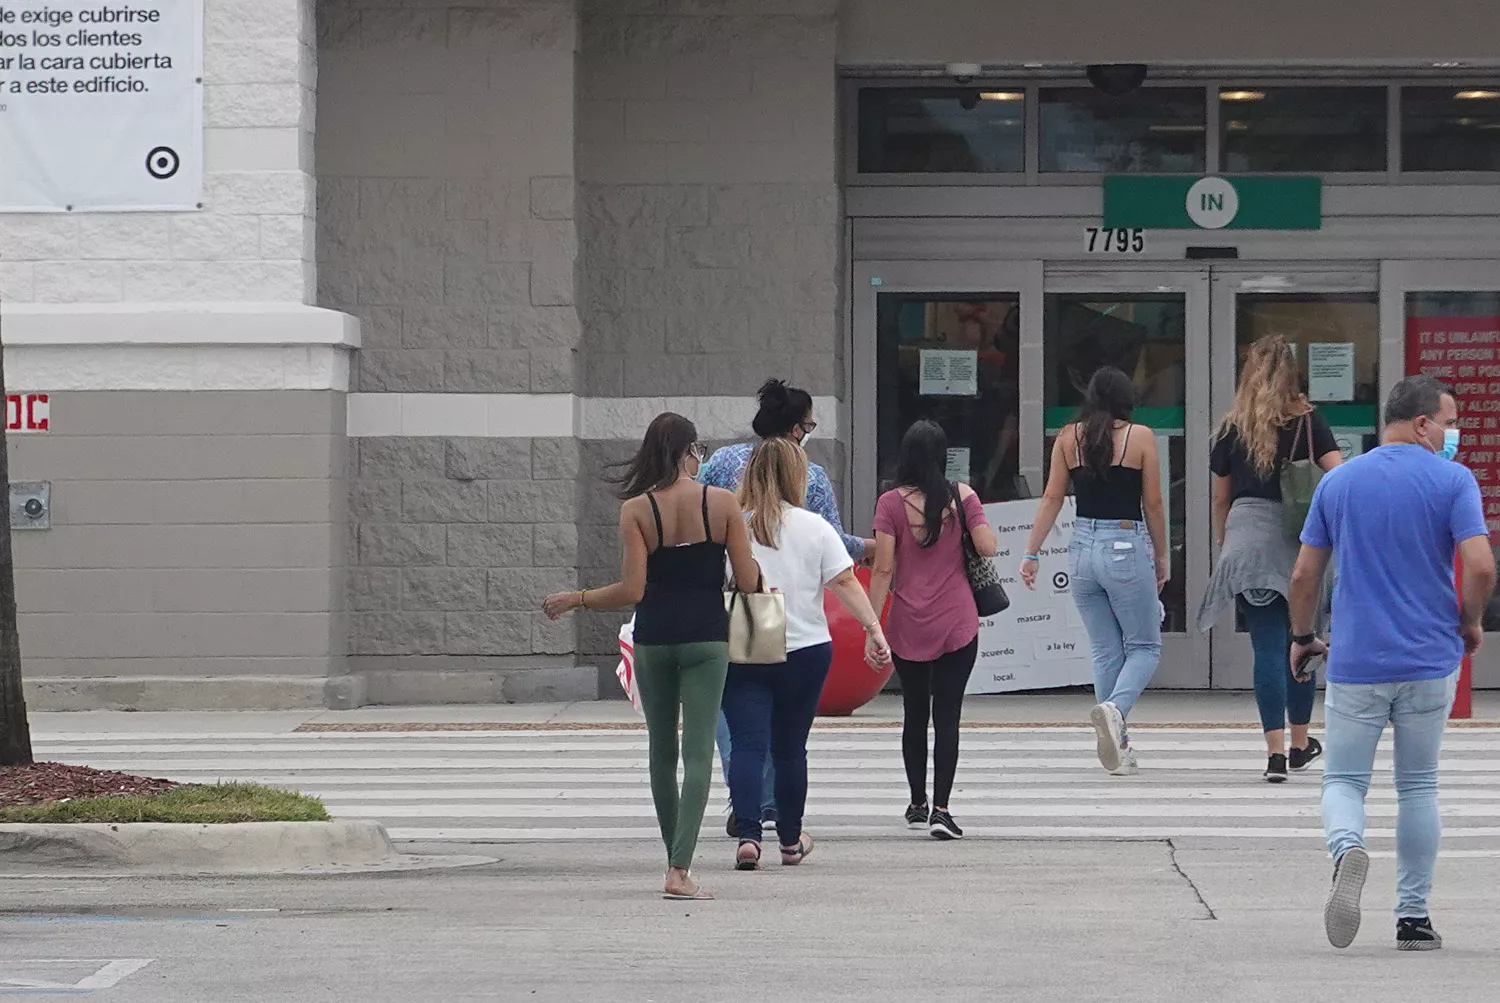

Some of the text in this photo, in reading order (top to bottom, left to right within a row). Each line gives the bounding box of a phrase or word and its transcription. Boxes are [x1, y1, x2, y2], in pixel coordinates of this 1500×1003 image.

[0, 5, 160, 27] e exige cubrirse
[0, 29, 142, 47] os los clientes
[19, 53, 35, 70] la
[40, 56, 84, 70] cara
[89, 52, 172, 69] cubierta
[10, 80, 21, 93] a
[26, 77, 68, 93] este
[73, 75, 149, 92] edificio.
[1200, 193, 1223, 211] IN
[1086, 228, 1144, 252] 7795
[1420, 331, 1431, 343] IT
[1433, 331, 1447, 344] IS
[1419, 349, 1444, 361] ANY
[1447, 348, 1494, 361] PERSON
[1458, 365, 1476, 377] OR
[1455, 382, 1486, 394] OPEN
[1483, 416, 1498, 429] IN
[1468, 451, 1494, 463] ANY
[998, 524, 1016, 533] face
[987, 619, 995, 627] la
[1017, 614, 1051, 623] mascara
[981, 647, 1014, 657] acuerdo
[1054, 642, 1061, 650] la
[1063, 642, 1075, 651] ley
[993, 673, 1015, 681] local.
